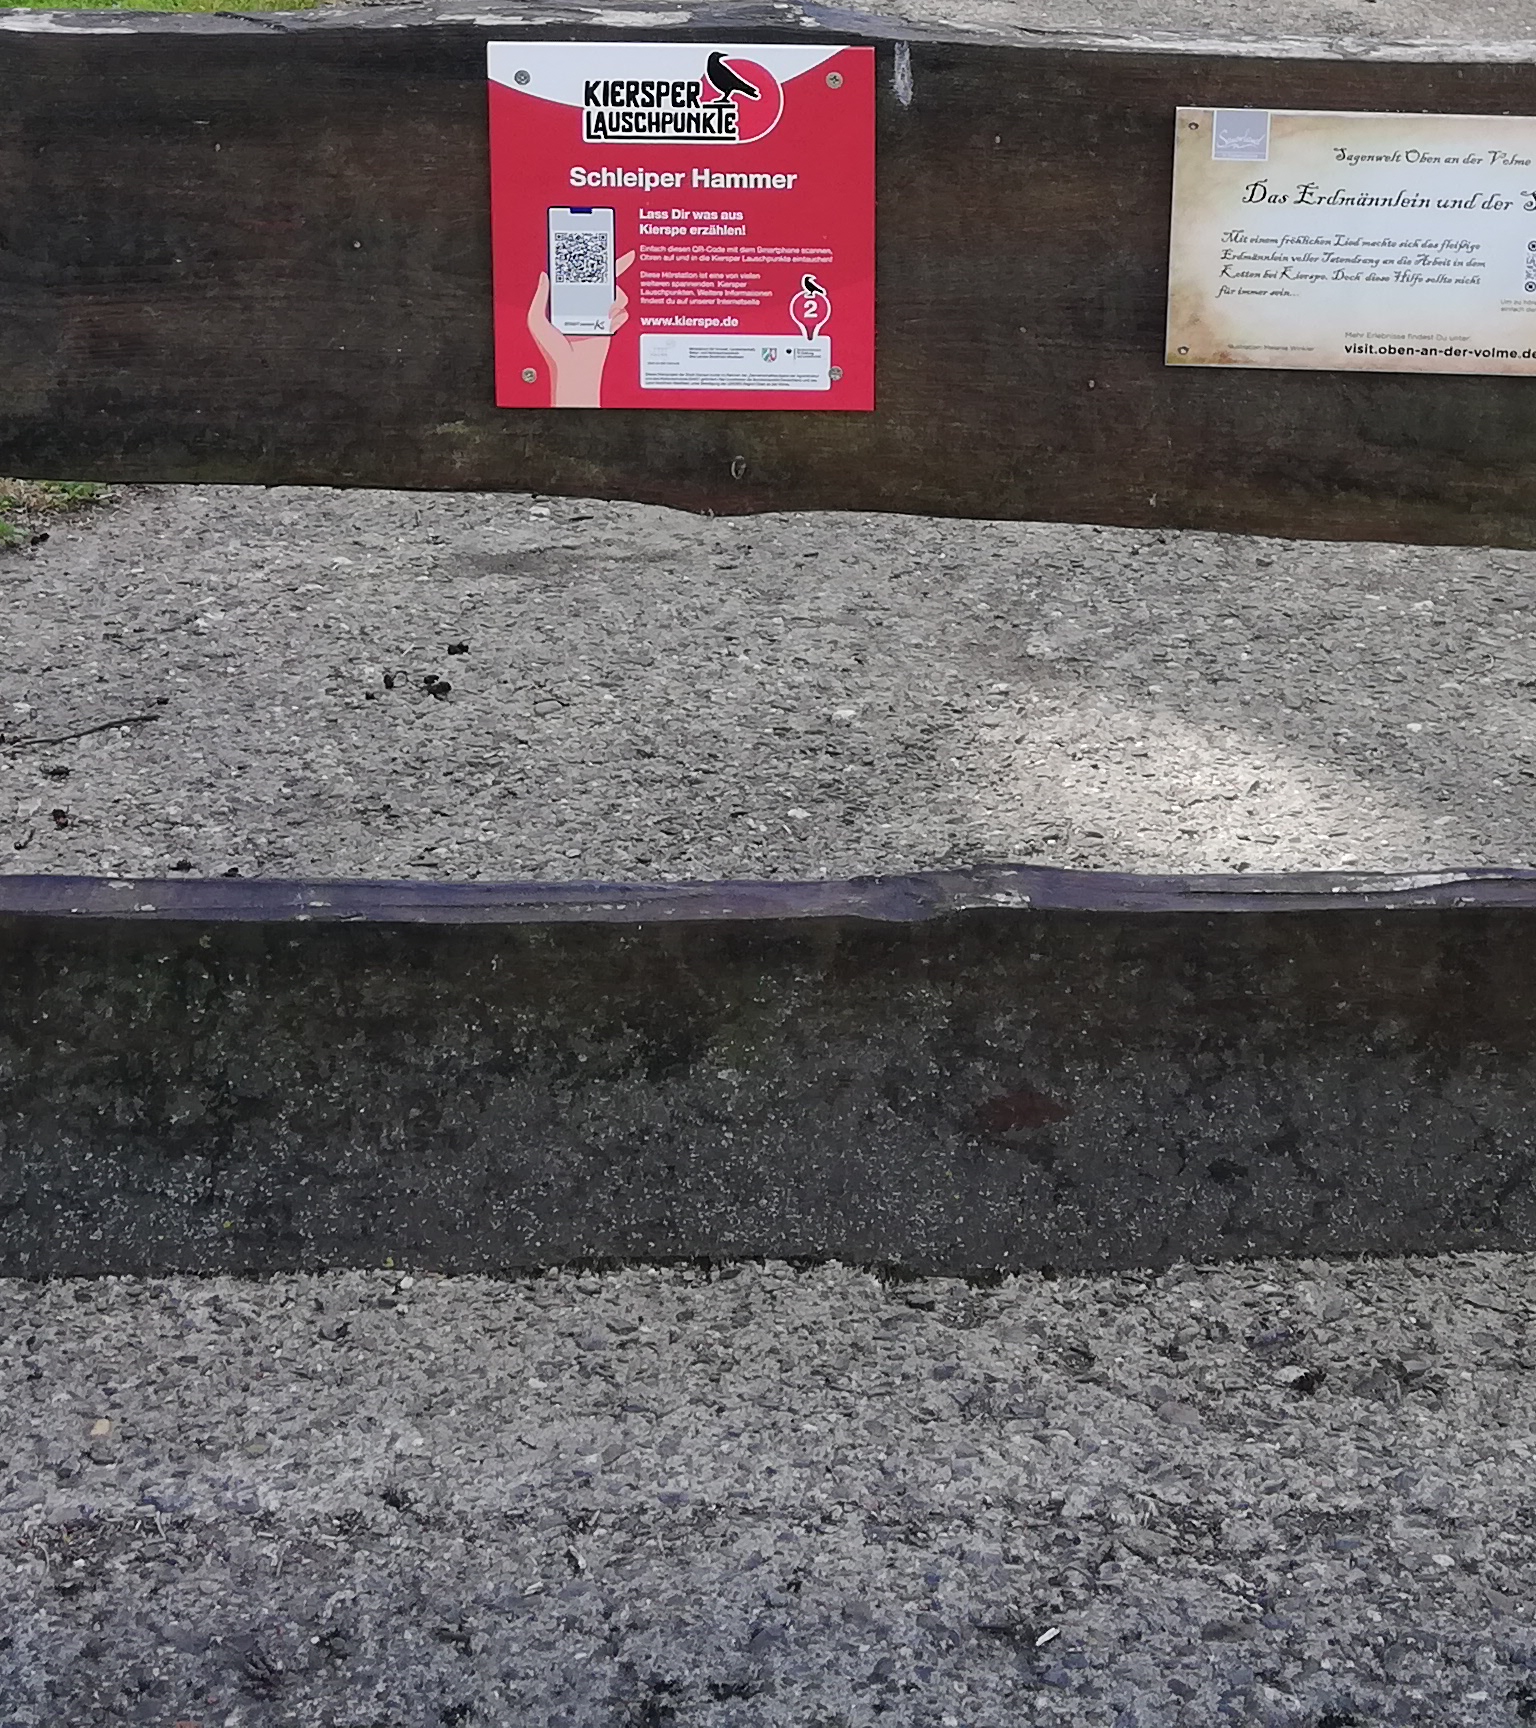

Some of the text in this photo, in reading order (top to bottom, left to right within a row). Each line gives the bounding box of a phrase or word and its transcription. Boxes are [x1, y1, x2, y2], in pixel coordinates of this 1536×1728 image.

[584, 80, 701, 108] KIERSPER
[586, 104, 737, 140] LAUSCHPUNKTE
[1333, 147, 1532, 166] Sagenwelt Oben an der Volme
[569, 167, 797, 191] Schleiper Hammer
[1242, 178, 1289, 204] Das
[1293, 182, 1431, 208] Erdmännlein
[1436, 192, 1483, 210] und
[1481, 193, 1514, 211] der
[639, 208, 743, 220] Lass Dir was aus
[639, 223, 746, 237] Kierspe erzählen!
[1221, 229, 1249, 244] Mit
[1277, 234, 1332, 248] fröhlichen
[1333, 234, 1363, 247] Lied
[1362, 238, 1397, 248] machte
[1399, 239, 1422, 248] sich
[1220, 248, 1289, 262] Erdmännlein
[1396, 256, 1412, 265] die
[1414, 253, 1452, 266] Arbeit
[1262, 269, 1279, 279] bei
[1454, 275, 1481, 285] nicht
[803, 301, 818, 319] 2
[640, 315, 739, 329] www.kierspe.de
